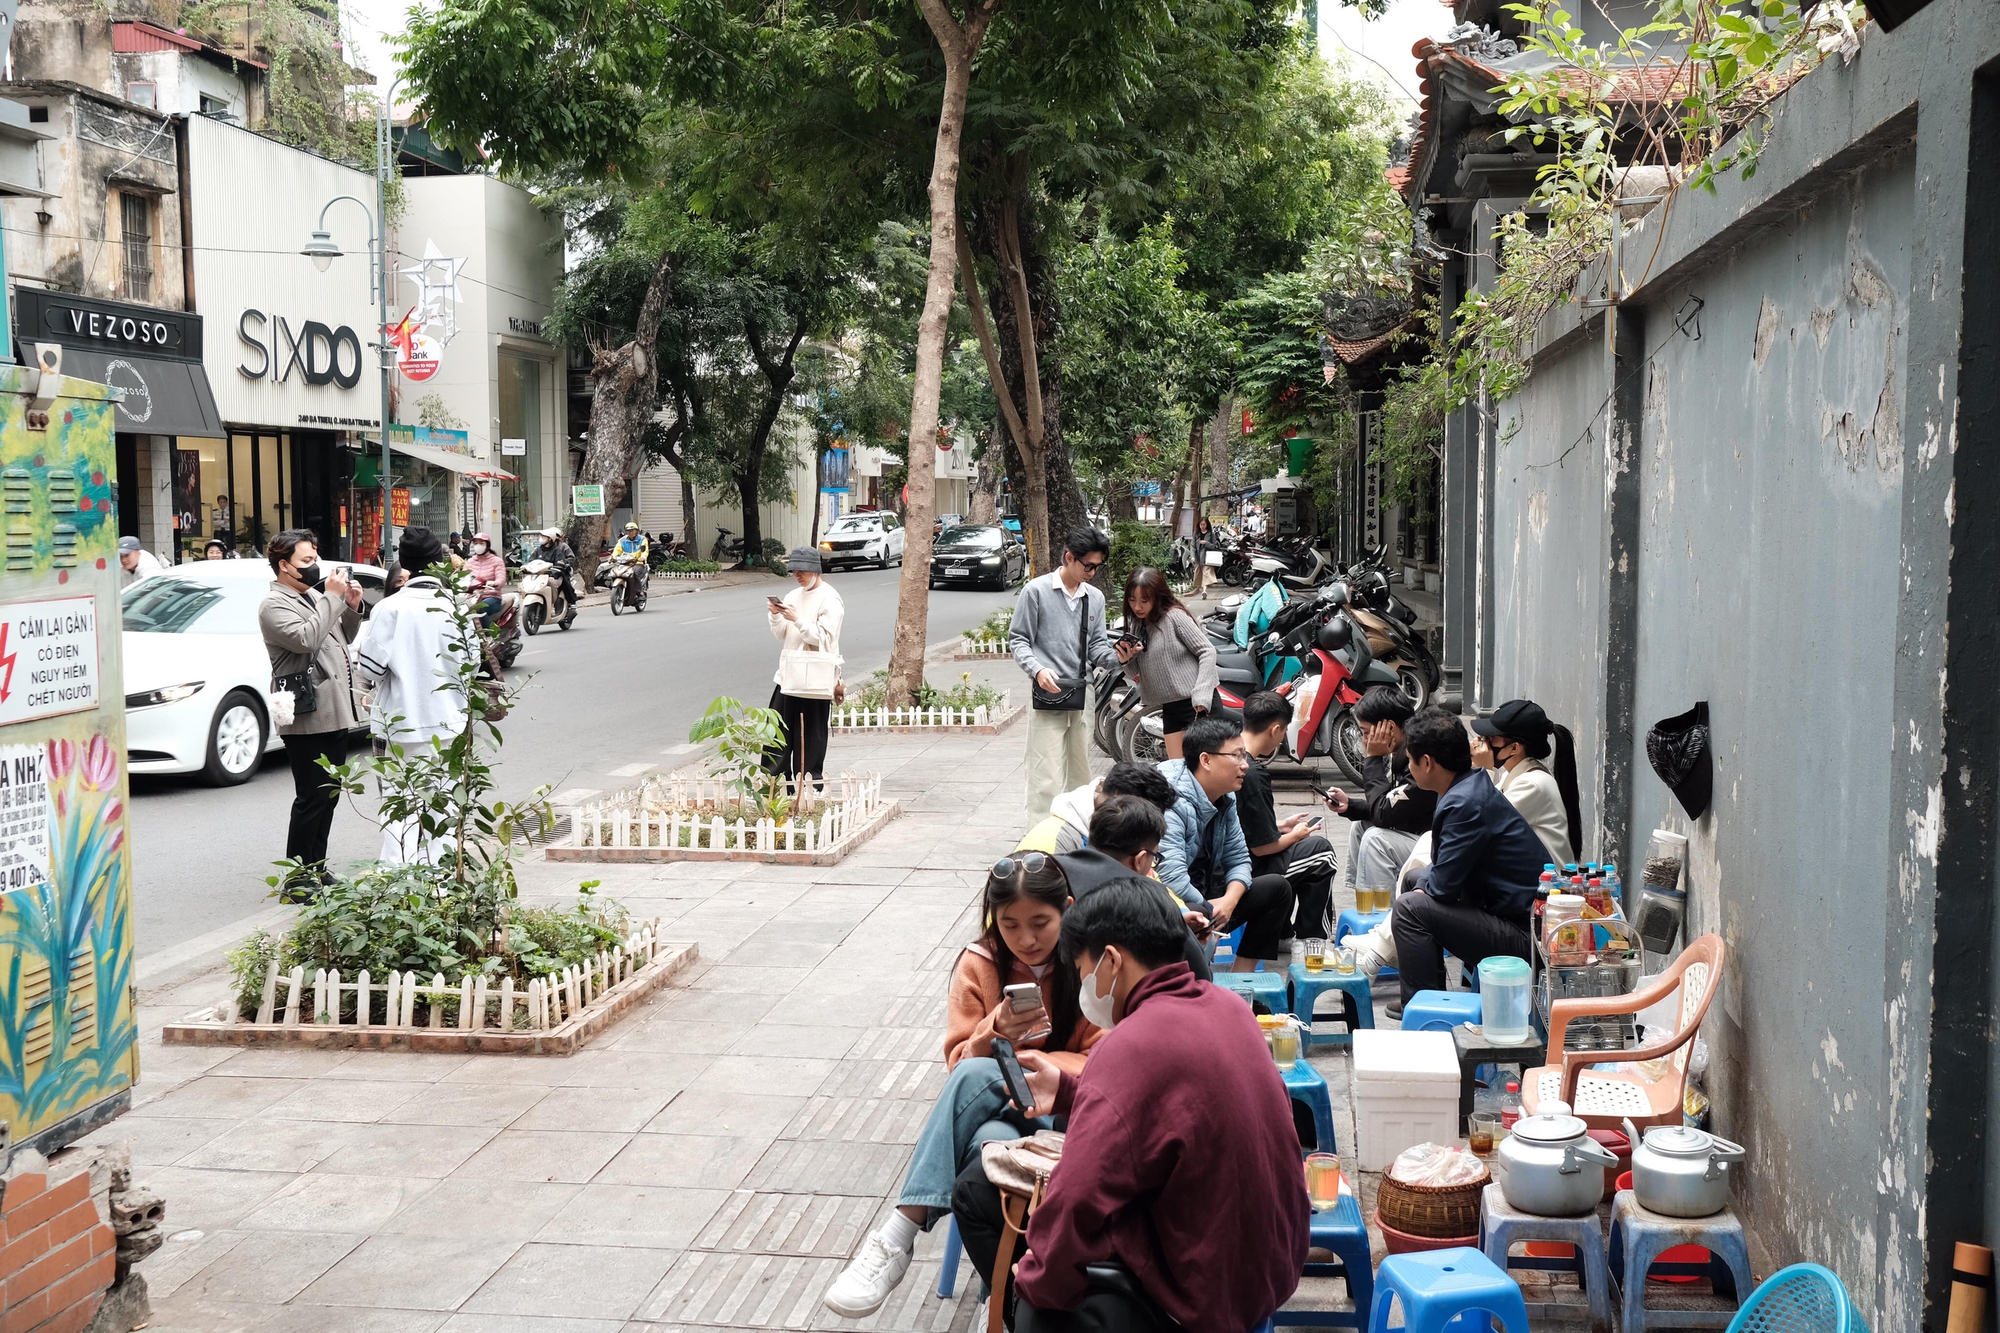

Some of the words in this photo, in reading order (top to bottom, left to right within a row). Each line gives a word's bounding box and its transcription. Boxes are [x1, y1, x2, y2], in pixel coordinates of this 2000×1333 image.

[69, 309, 168, 345] VEZOSO
[236, 308, 362, 390] SIXDO
[412, 350, 428, 360] ank
[46, 617, 63, 640] LẠI
[38, 645, 53, 661] CÓ
[56, 644, 79, 661] ĐIỆN
[31, 667, 60, 684] NGUY
[58, 683, 91, 702] NGƯỜI
[10, 866, 26, 888] 407
[30, 864, 45, 884] 34
